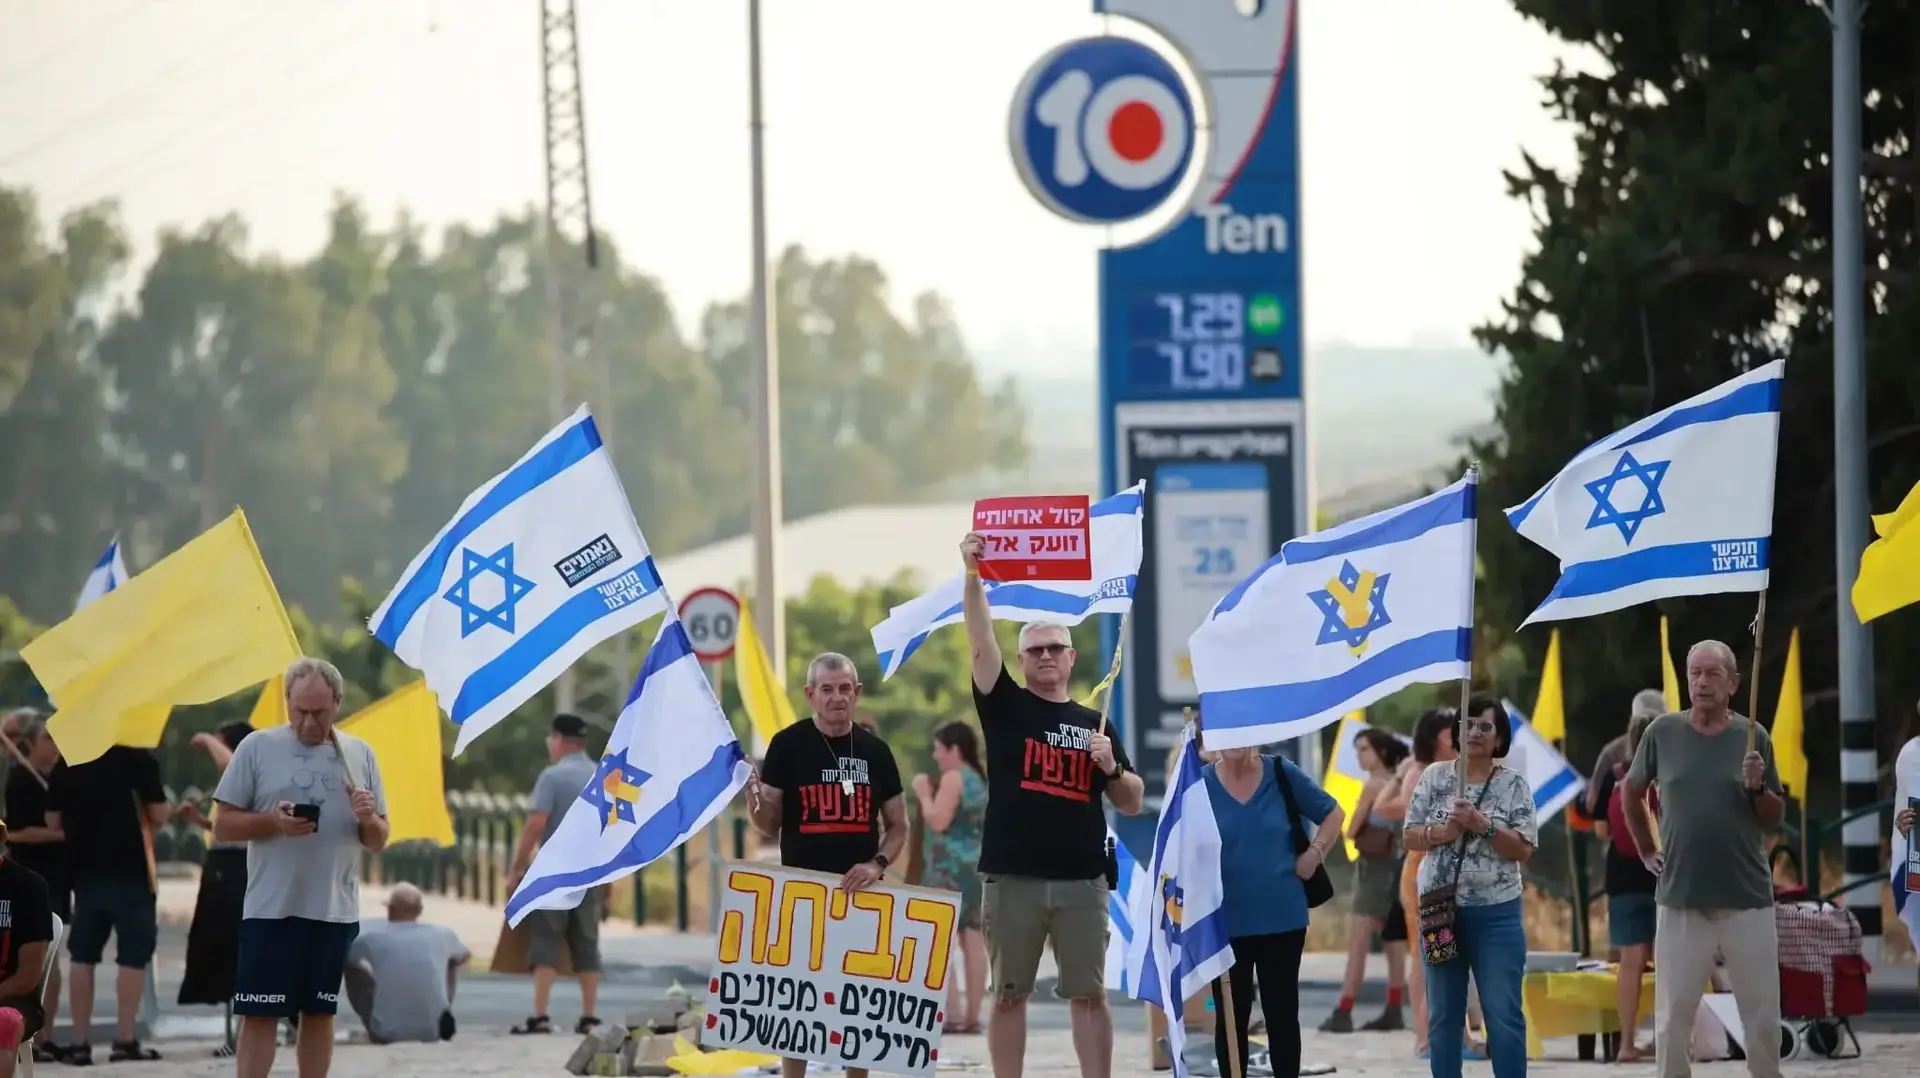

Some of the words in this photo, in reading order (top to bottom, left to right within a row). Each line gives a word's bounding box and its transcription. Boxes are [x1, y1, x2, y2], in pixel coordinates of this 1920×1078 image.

[1036, 69, 1188, 190] 10
[1195, 204, 1287, 253] Ten
[1155, 293, 1244, 341] 7.29
[1156, 342, 1244, 390] 7.90
[1049, 507, 1085, 526] קול
[558, 538, 613, 577] נאמנים
[1029, 535, 1079, 554] זועק
[1711, 541, 1758, 557] חופשי
[1711, 554, 1759, 571] בארצנו
[596, 570, 641, 597] חופשי
[603, 582, 648, 610] בארצנו
[690, 612, 733, 642] 60
[1072, 736, 1091, 751] ותם
[719, 871, 955, 990] הביתה
[240, 992, 286, 1003] UNDER
[719, 971, 818, 1012] מפונים
[839, 982, 939, 1032] חטופים
[719, 1008, 827, 1055] הממשלה
[839, 1025, 930, 1070] חיילים
